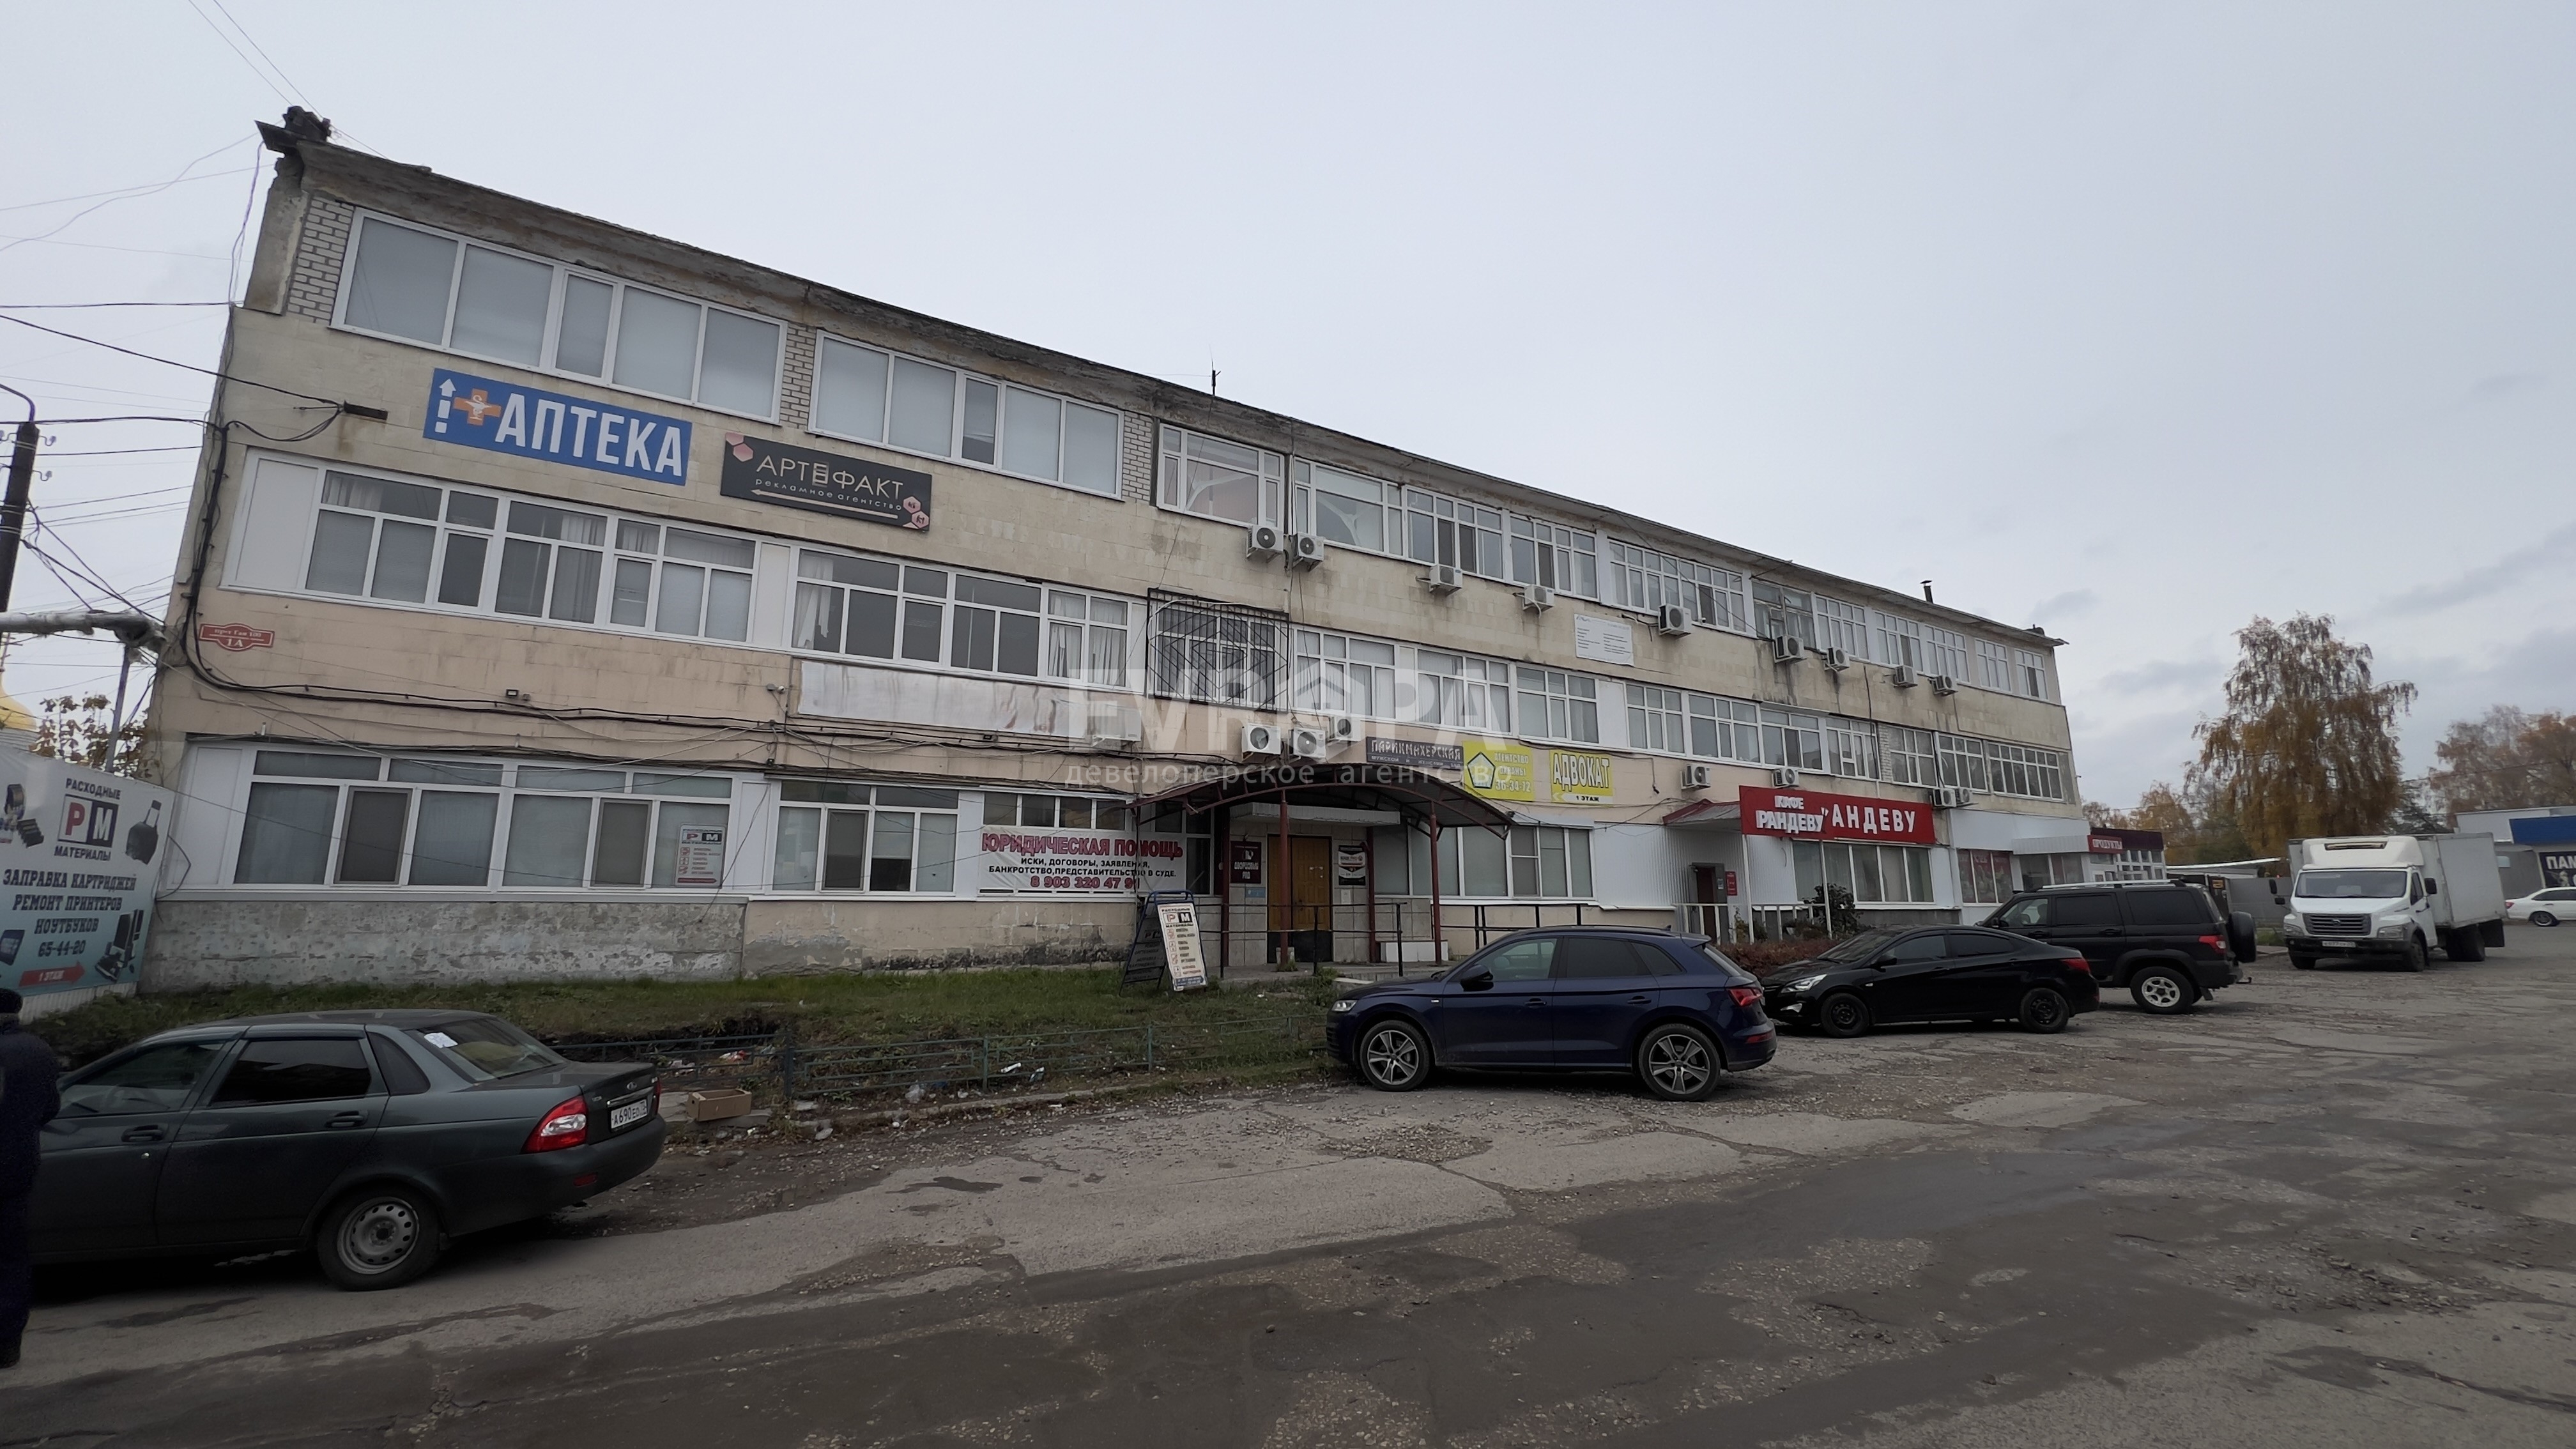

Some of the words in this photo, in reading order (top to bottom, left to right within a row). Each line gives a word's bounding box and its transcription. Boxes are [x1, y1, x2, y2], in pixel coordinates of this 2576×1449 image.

[494, 392, 682, 477] АПТЕКА
[755, 479, 833, 498] рекламное
[838, 493, 902, 511] агентство
[1370, 739, 1460, 760] ПАРИКМАХЕРСКАЯ
[1494, 753, 1529, 765] АГЕНТСТВО
[1553, 753, 1610, 792] АДВОКАТ
[65, 778, 121, 800] РАСХОДНЫЕ
[1495, 779, 1531, 793] 36-34-72
[1774, 795, 1804, 809] КАФЕ
[54, 845, 111, 861] МАТЕРИАЛЫ
[981, 832, 1110, 857] ЮРИДИЧЕСКАЯ
[1114, 839, 1183, 861] ПОМОЩЬ
[2092, 838, 2123, 850] ПРОДУКТЫ
[1048, 859, 1098, 868] ДОГОВОРЫ,
[3, 869, 67, 888] ЗАПРАВКА
[71, 873, 137, 893] КАРТРИДЖЕЙ
[1030, 875, 1040, 888] 8
[1043, 876, 1071, 888] 903
[1074, 877, 1100, 889] 320
[1103, 877, 1121, 889] 47
[12, 894, 63, 911] РЕМОНТ
[65, 895, 123, 912] ПРИНТЕРОВ
[34, 917, 100, 935] НОУТБУКОВ
[38, 940, 87, 957] 65-44-20
